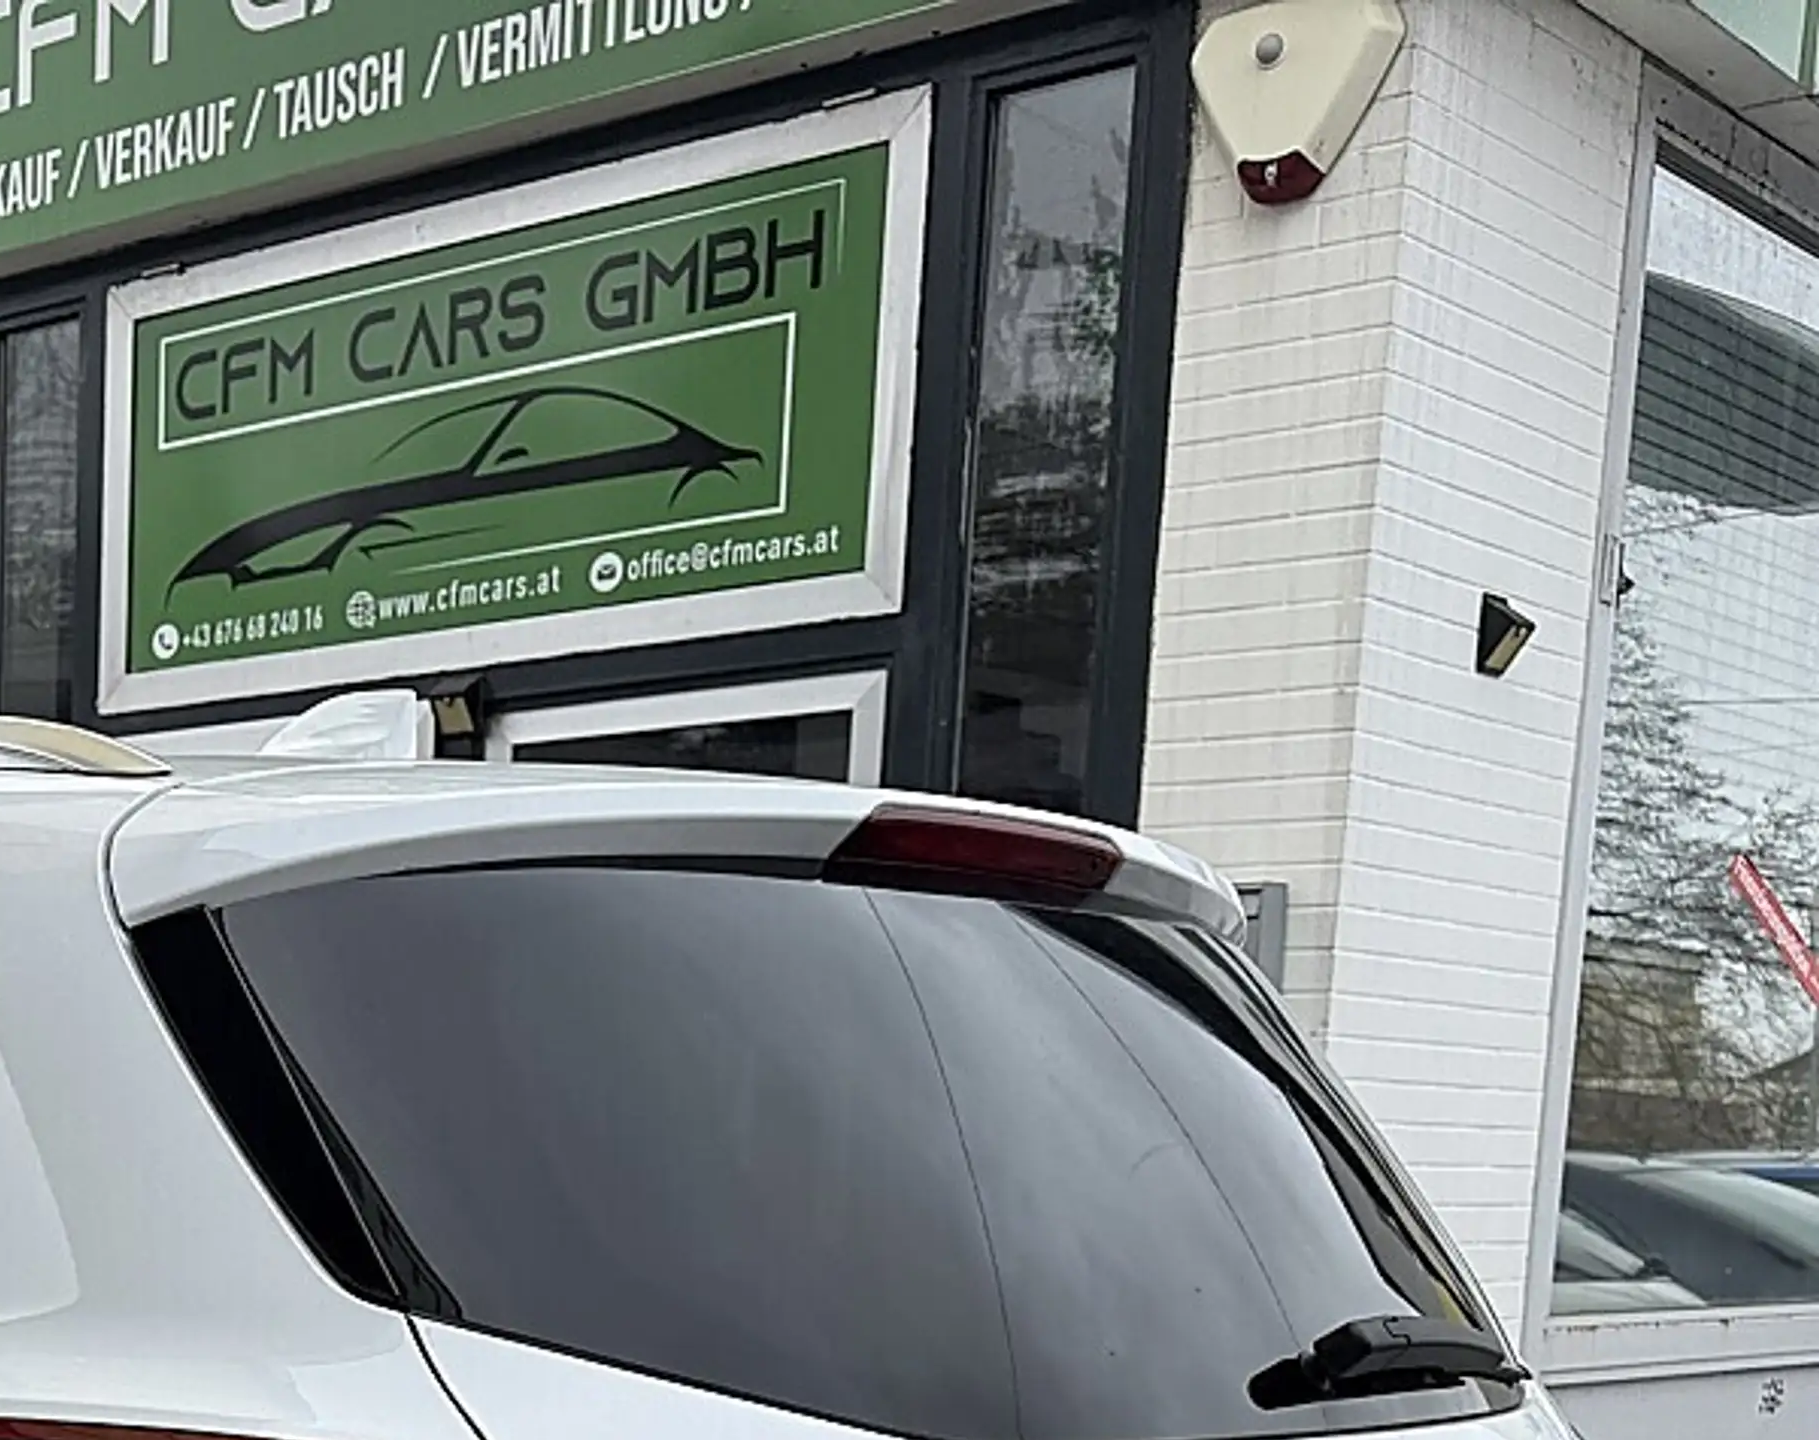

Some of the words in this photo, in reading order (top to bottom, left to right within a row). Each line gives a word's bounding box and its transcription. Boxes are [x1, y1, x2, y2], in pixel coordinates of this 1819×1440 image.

[94, 97, 236, 190] VERKAUF
[272, 47, 406, 139] TAUSCH
[176, 329, 316, 421] CFM
[348, 275, 545, 383] CARS
[586, 208, 825, 332] GMBH
[627, 525, 840, 582] office@cfmcars.at
[304, 604, 323, 632] 16
[378, 566, 561, 620] www.cfmcars.at
